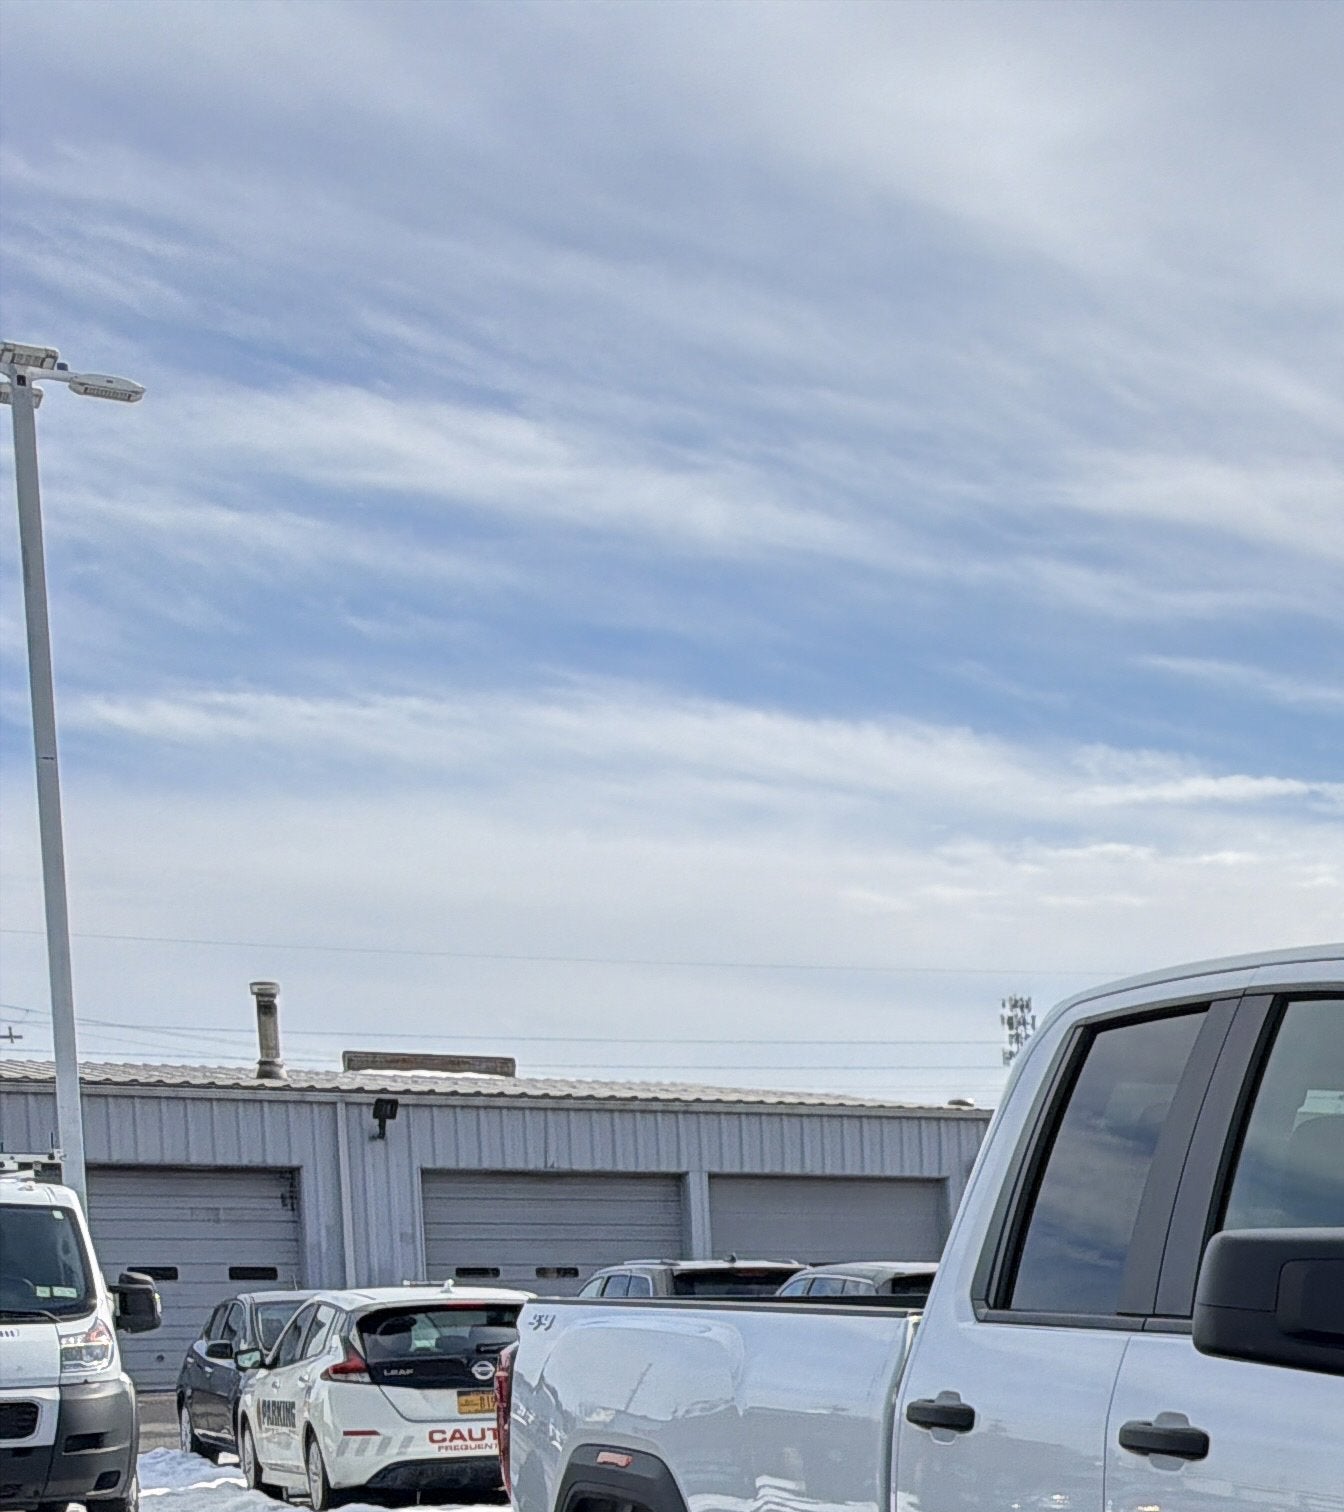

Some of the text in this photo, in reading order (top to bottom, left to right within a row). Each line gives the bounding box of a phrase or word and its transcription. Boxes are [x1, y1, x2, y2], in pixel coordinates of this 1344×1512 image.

[383, 1368, 414, 1377] LEAF
[262, 1399, 296, 1429] PARKING
[428, 1427, 499, 1444] CAUT
